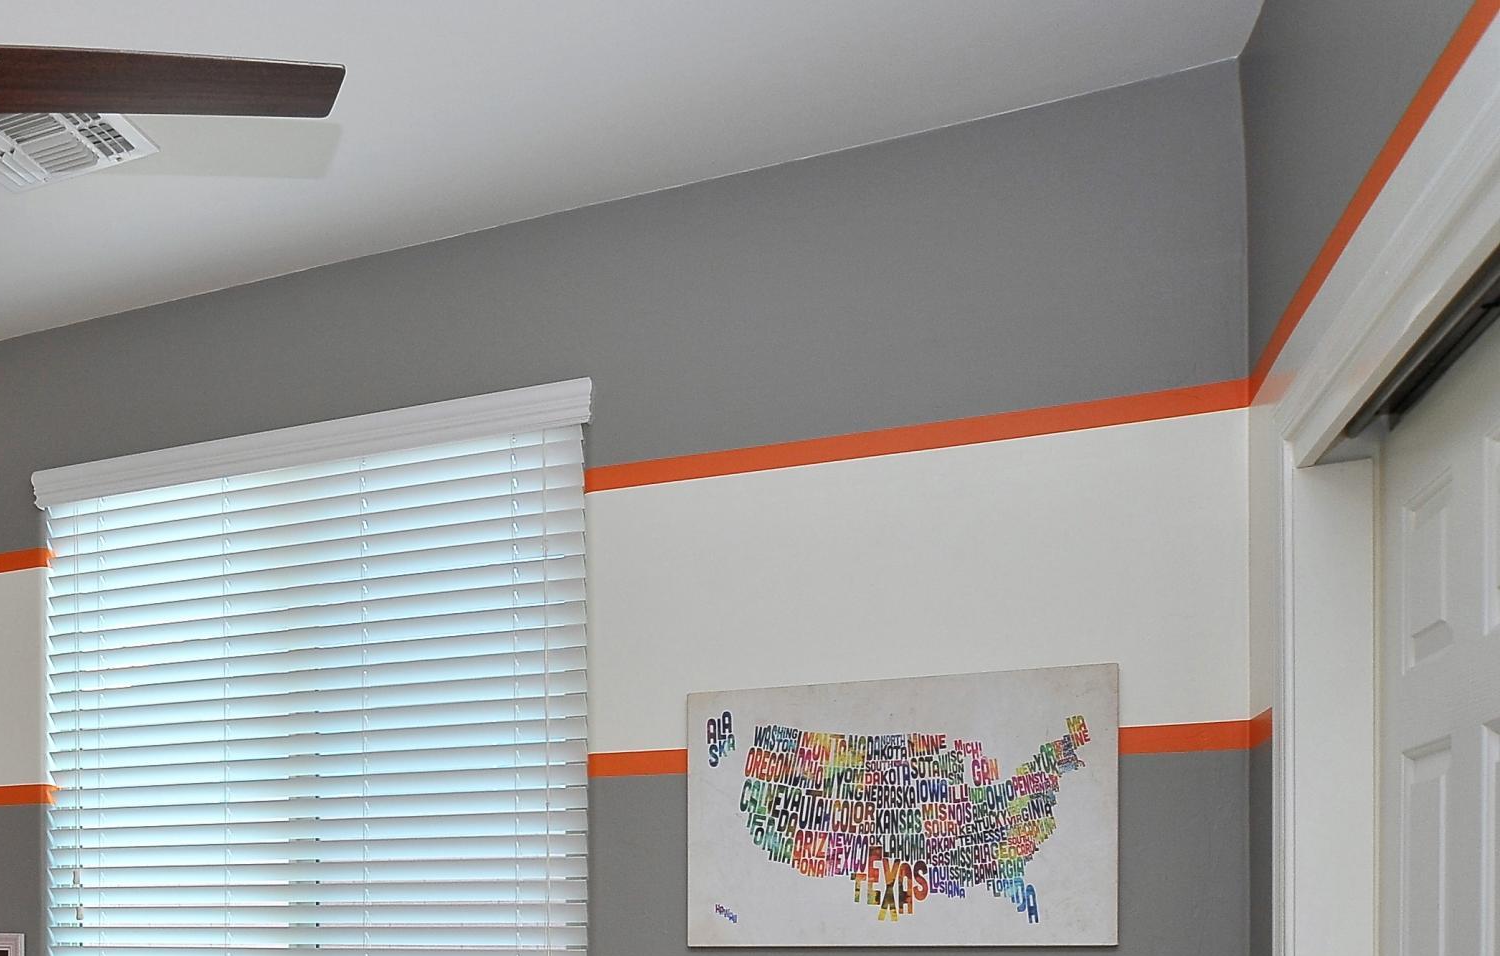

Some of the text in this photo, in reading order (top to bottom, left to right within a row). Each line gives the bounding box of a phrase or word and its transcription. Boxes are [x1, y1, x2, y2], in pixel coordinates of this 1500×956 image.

[744, 747, 792, 784] OREGON
[864, 785, 916, 808] NEBRASKA
[916, 780, 948, 803] IOWA
[986, 780, 1014, 811] OHIO
[800, 789, 833, 831] UTAH
[876, 809, 922, 834] KANSAS
[850, 846, 929, 921] TEXAS
